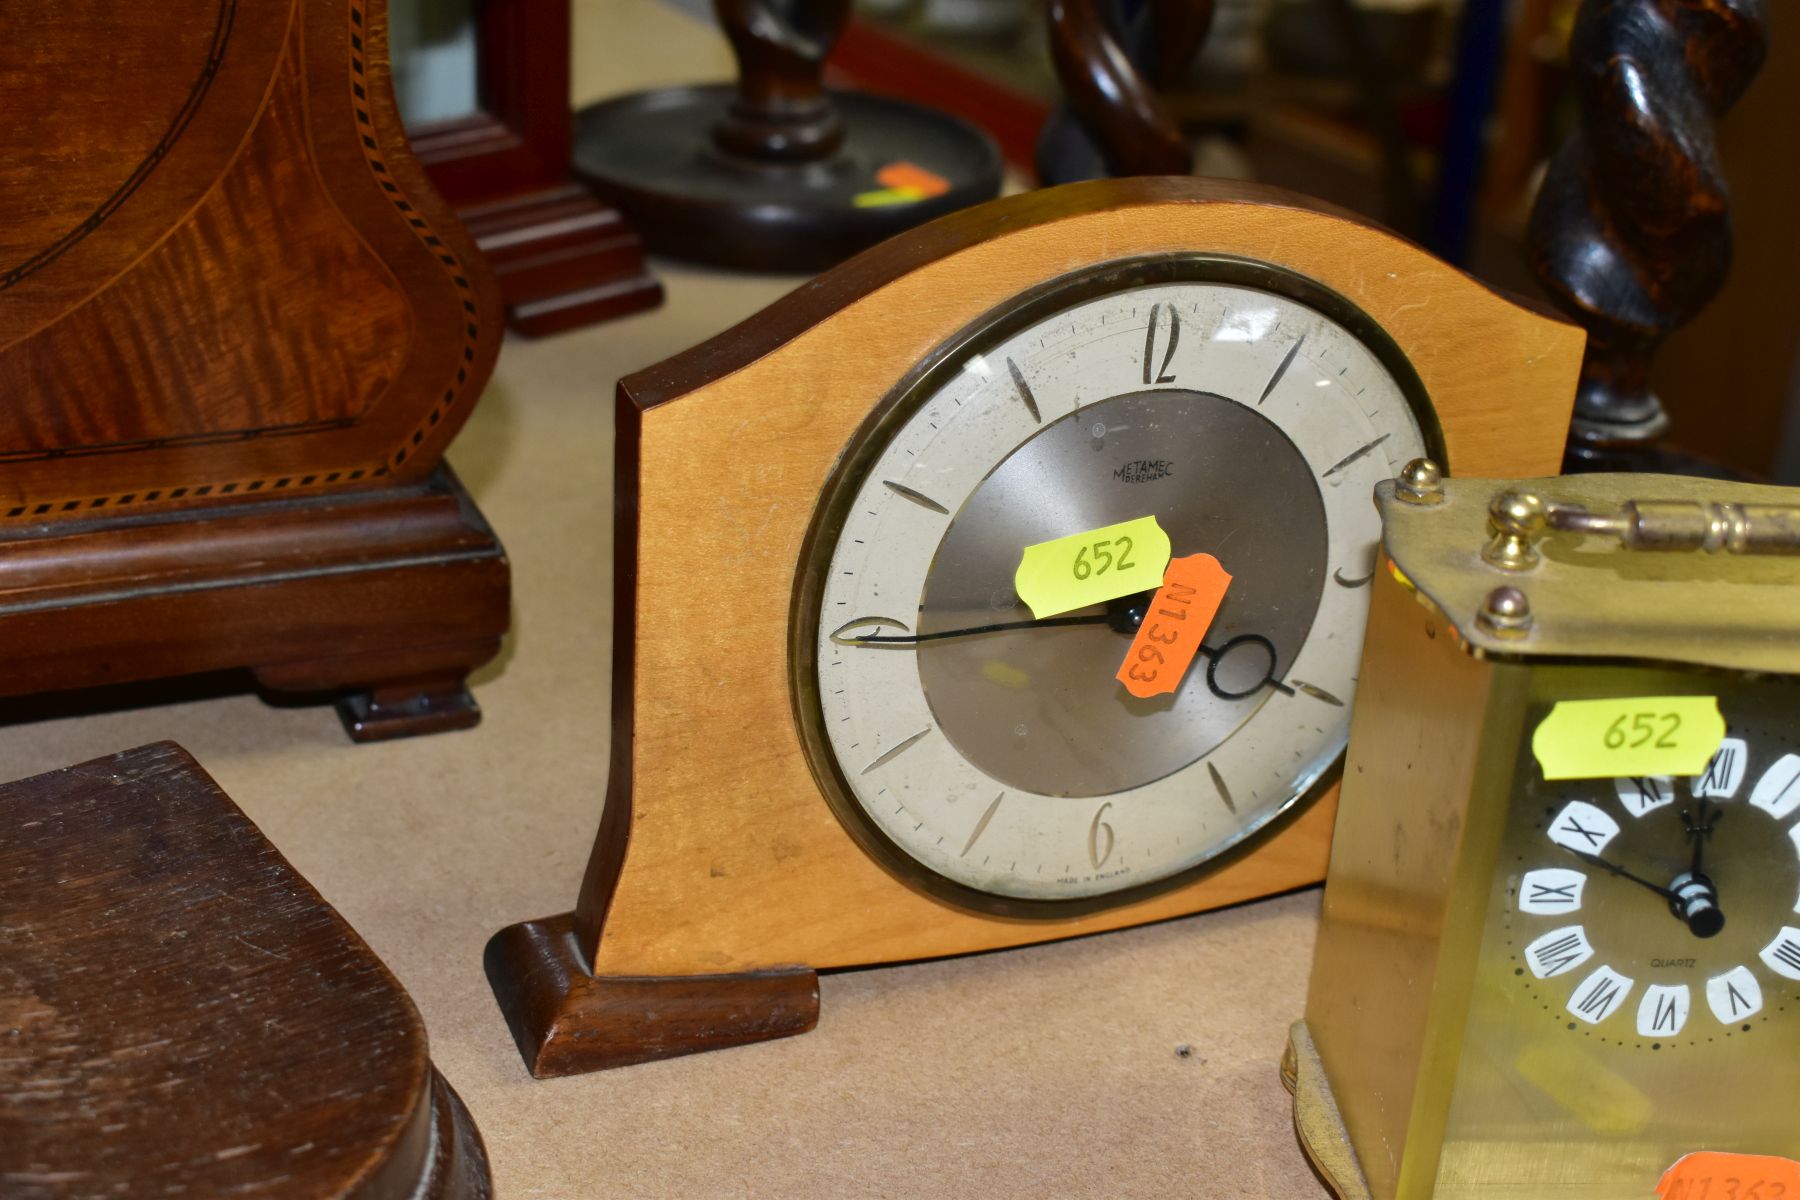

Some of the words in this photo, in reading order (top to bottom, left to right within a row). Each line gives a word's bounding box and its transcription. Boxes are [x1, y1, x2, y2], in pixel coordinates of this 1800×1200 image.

[1143, 303, 1180, 384] 12
[1113, 460, 1174, 482] METAMEC
[1125, 472, 1164, 483] DEREHAM
[1073, 536, 1135, 580] 652
[1129, 583, 1196, 682] N1363
[1604, 713, 1682, 749] 652
[1702, 748, 1735, 790] XII
[1088, 801, 1114, 870] 6
[1561, 816, 1605, 847] X
[1529, 884, 1577, 903] IX
[1534, 933, 1584, 977] VIII
[1650, 958, 1697, 968] QUARTZ
[1578, 977, 1621, 1021] VII
[1652, 994, 1676, 1031] VI
[1727, 981, 1751, 1016] V
